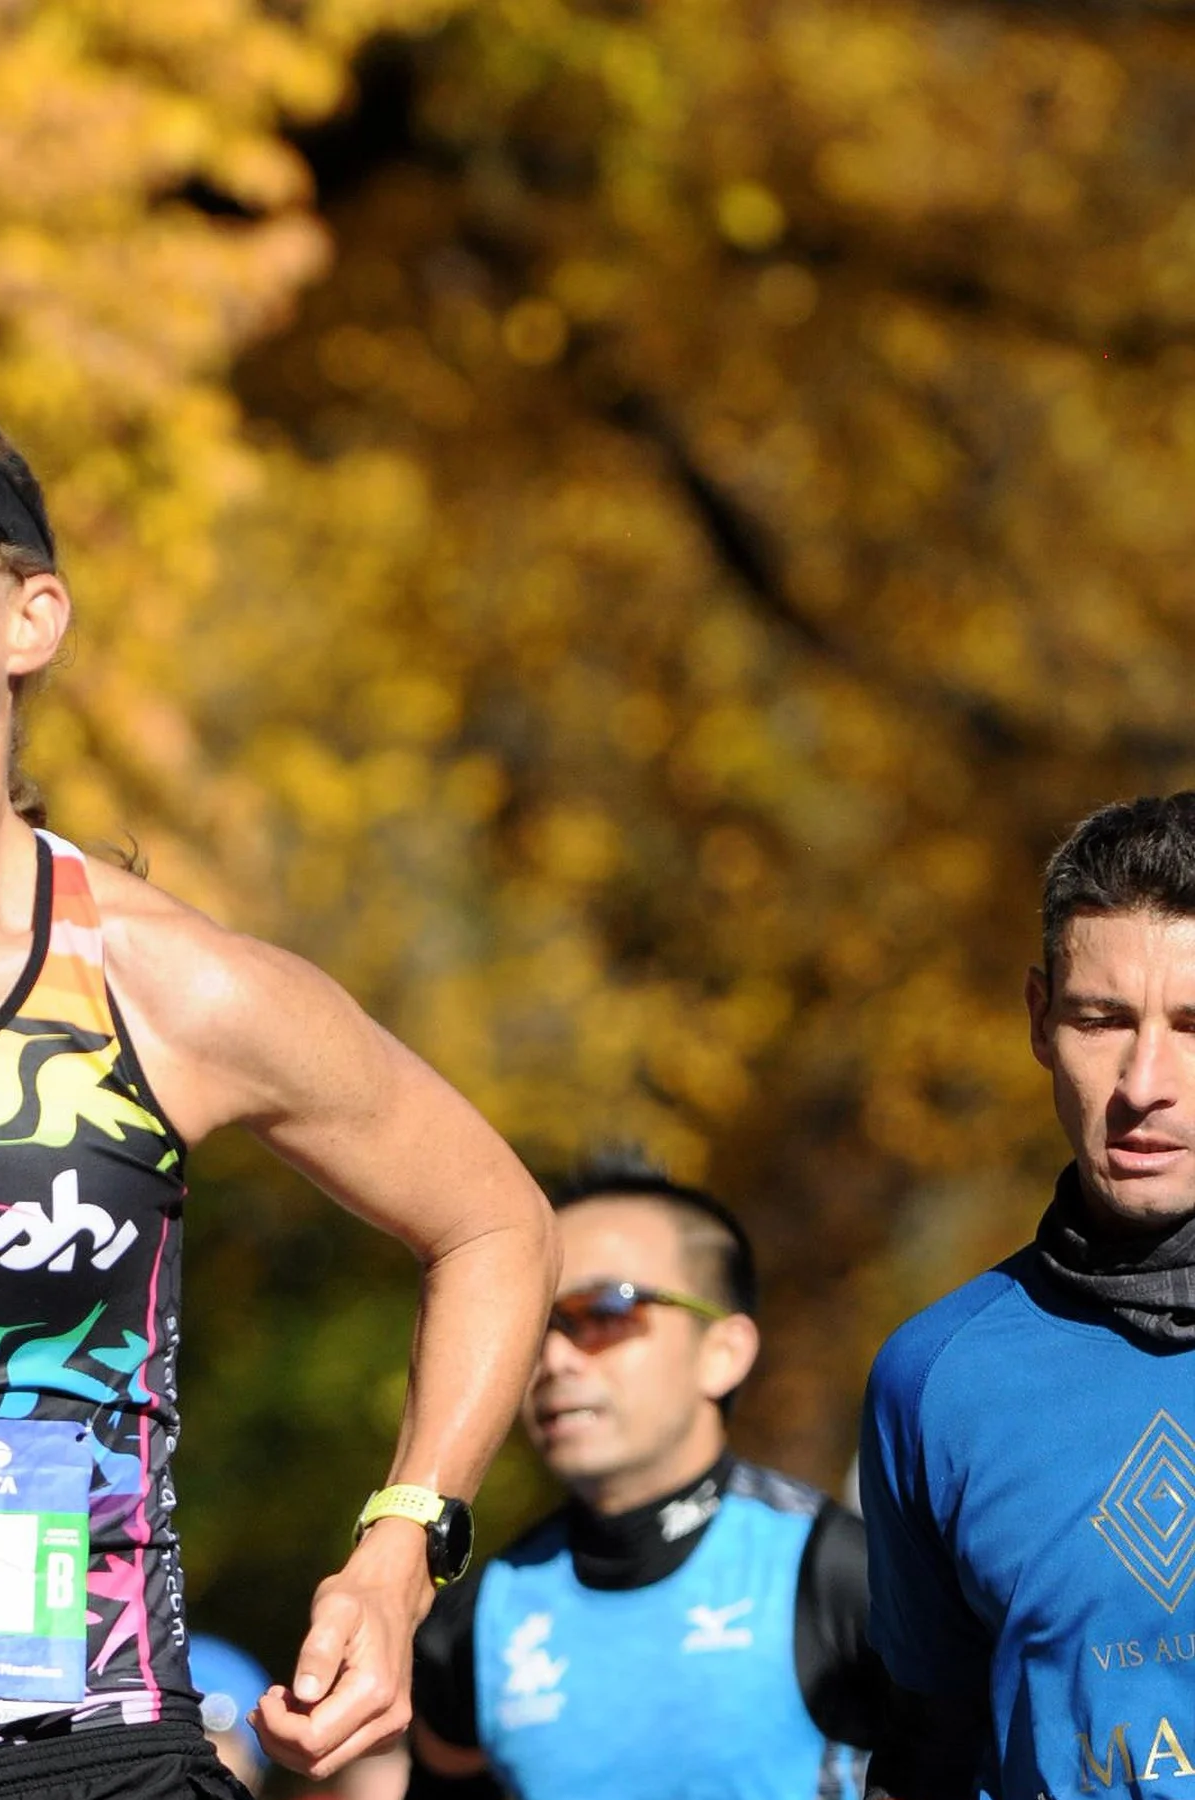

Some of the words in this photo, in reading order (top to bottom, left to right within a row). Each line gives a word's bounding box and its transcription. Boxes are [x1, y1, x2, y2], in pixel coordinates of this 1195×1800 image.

[46, 1552, 76, 1609] B
[1091, 1639, 1144, 1672] VIS
[1074, 1716, 1195, 1791] MA
